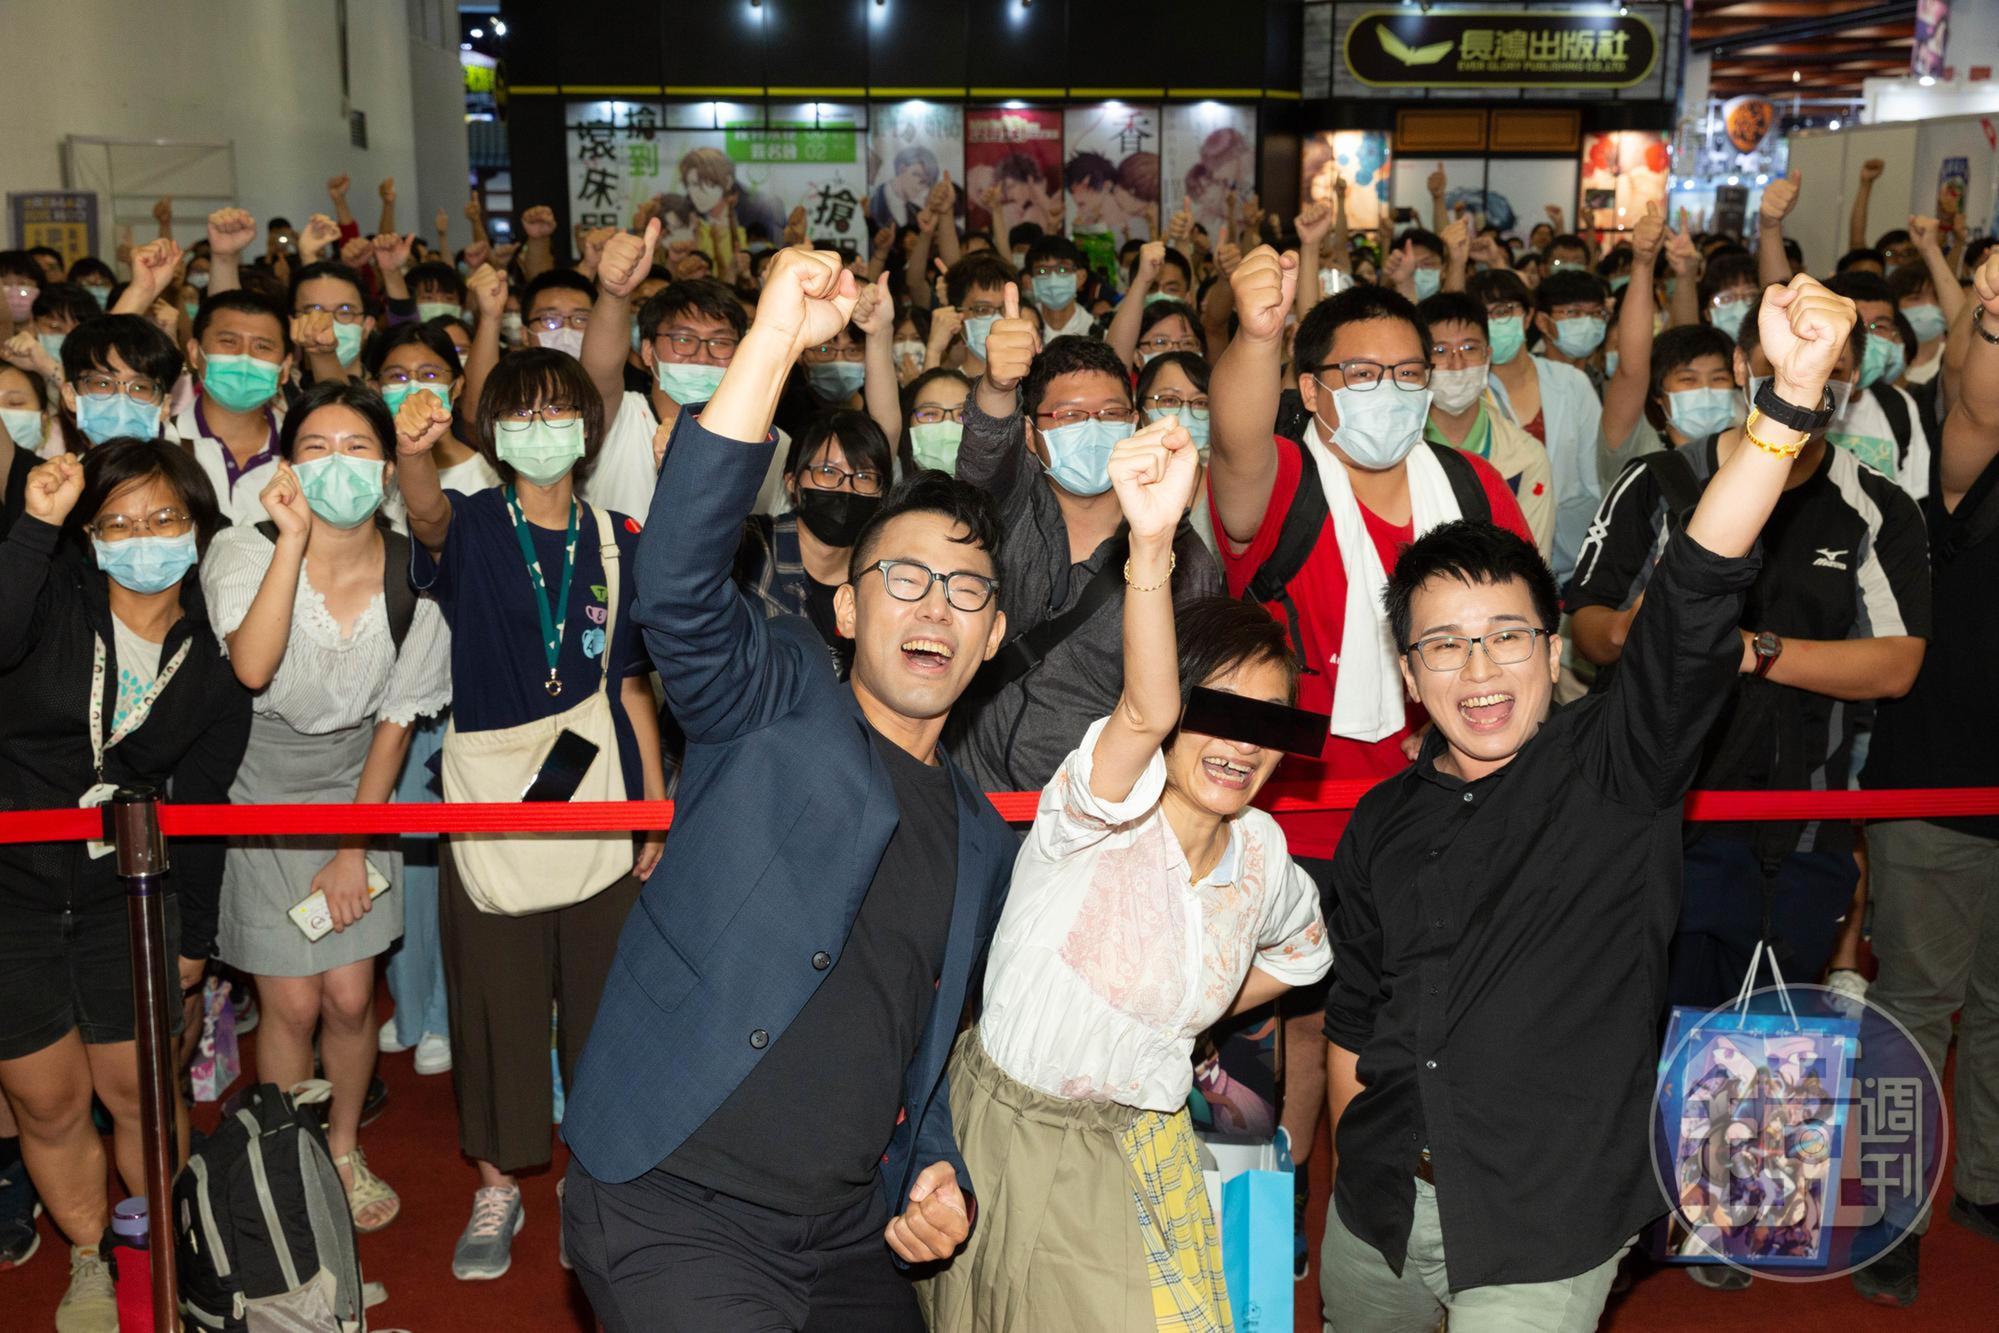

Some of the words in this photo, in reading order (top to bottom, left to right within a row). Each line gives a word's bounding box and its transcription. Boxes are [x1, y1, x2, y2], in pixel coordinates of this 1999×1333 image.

[1460, 29, 1630, 61] 長鴻出版社
